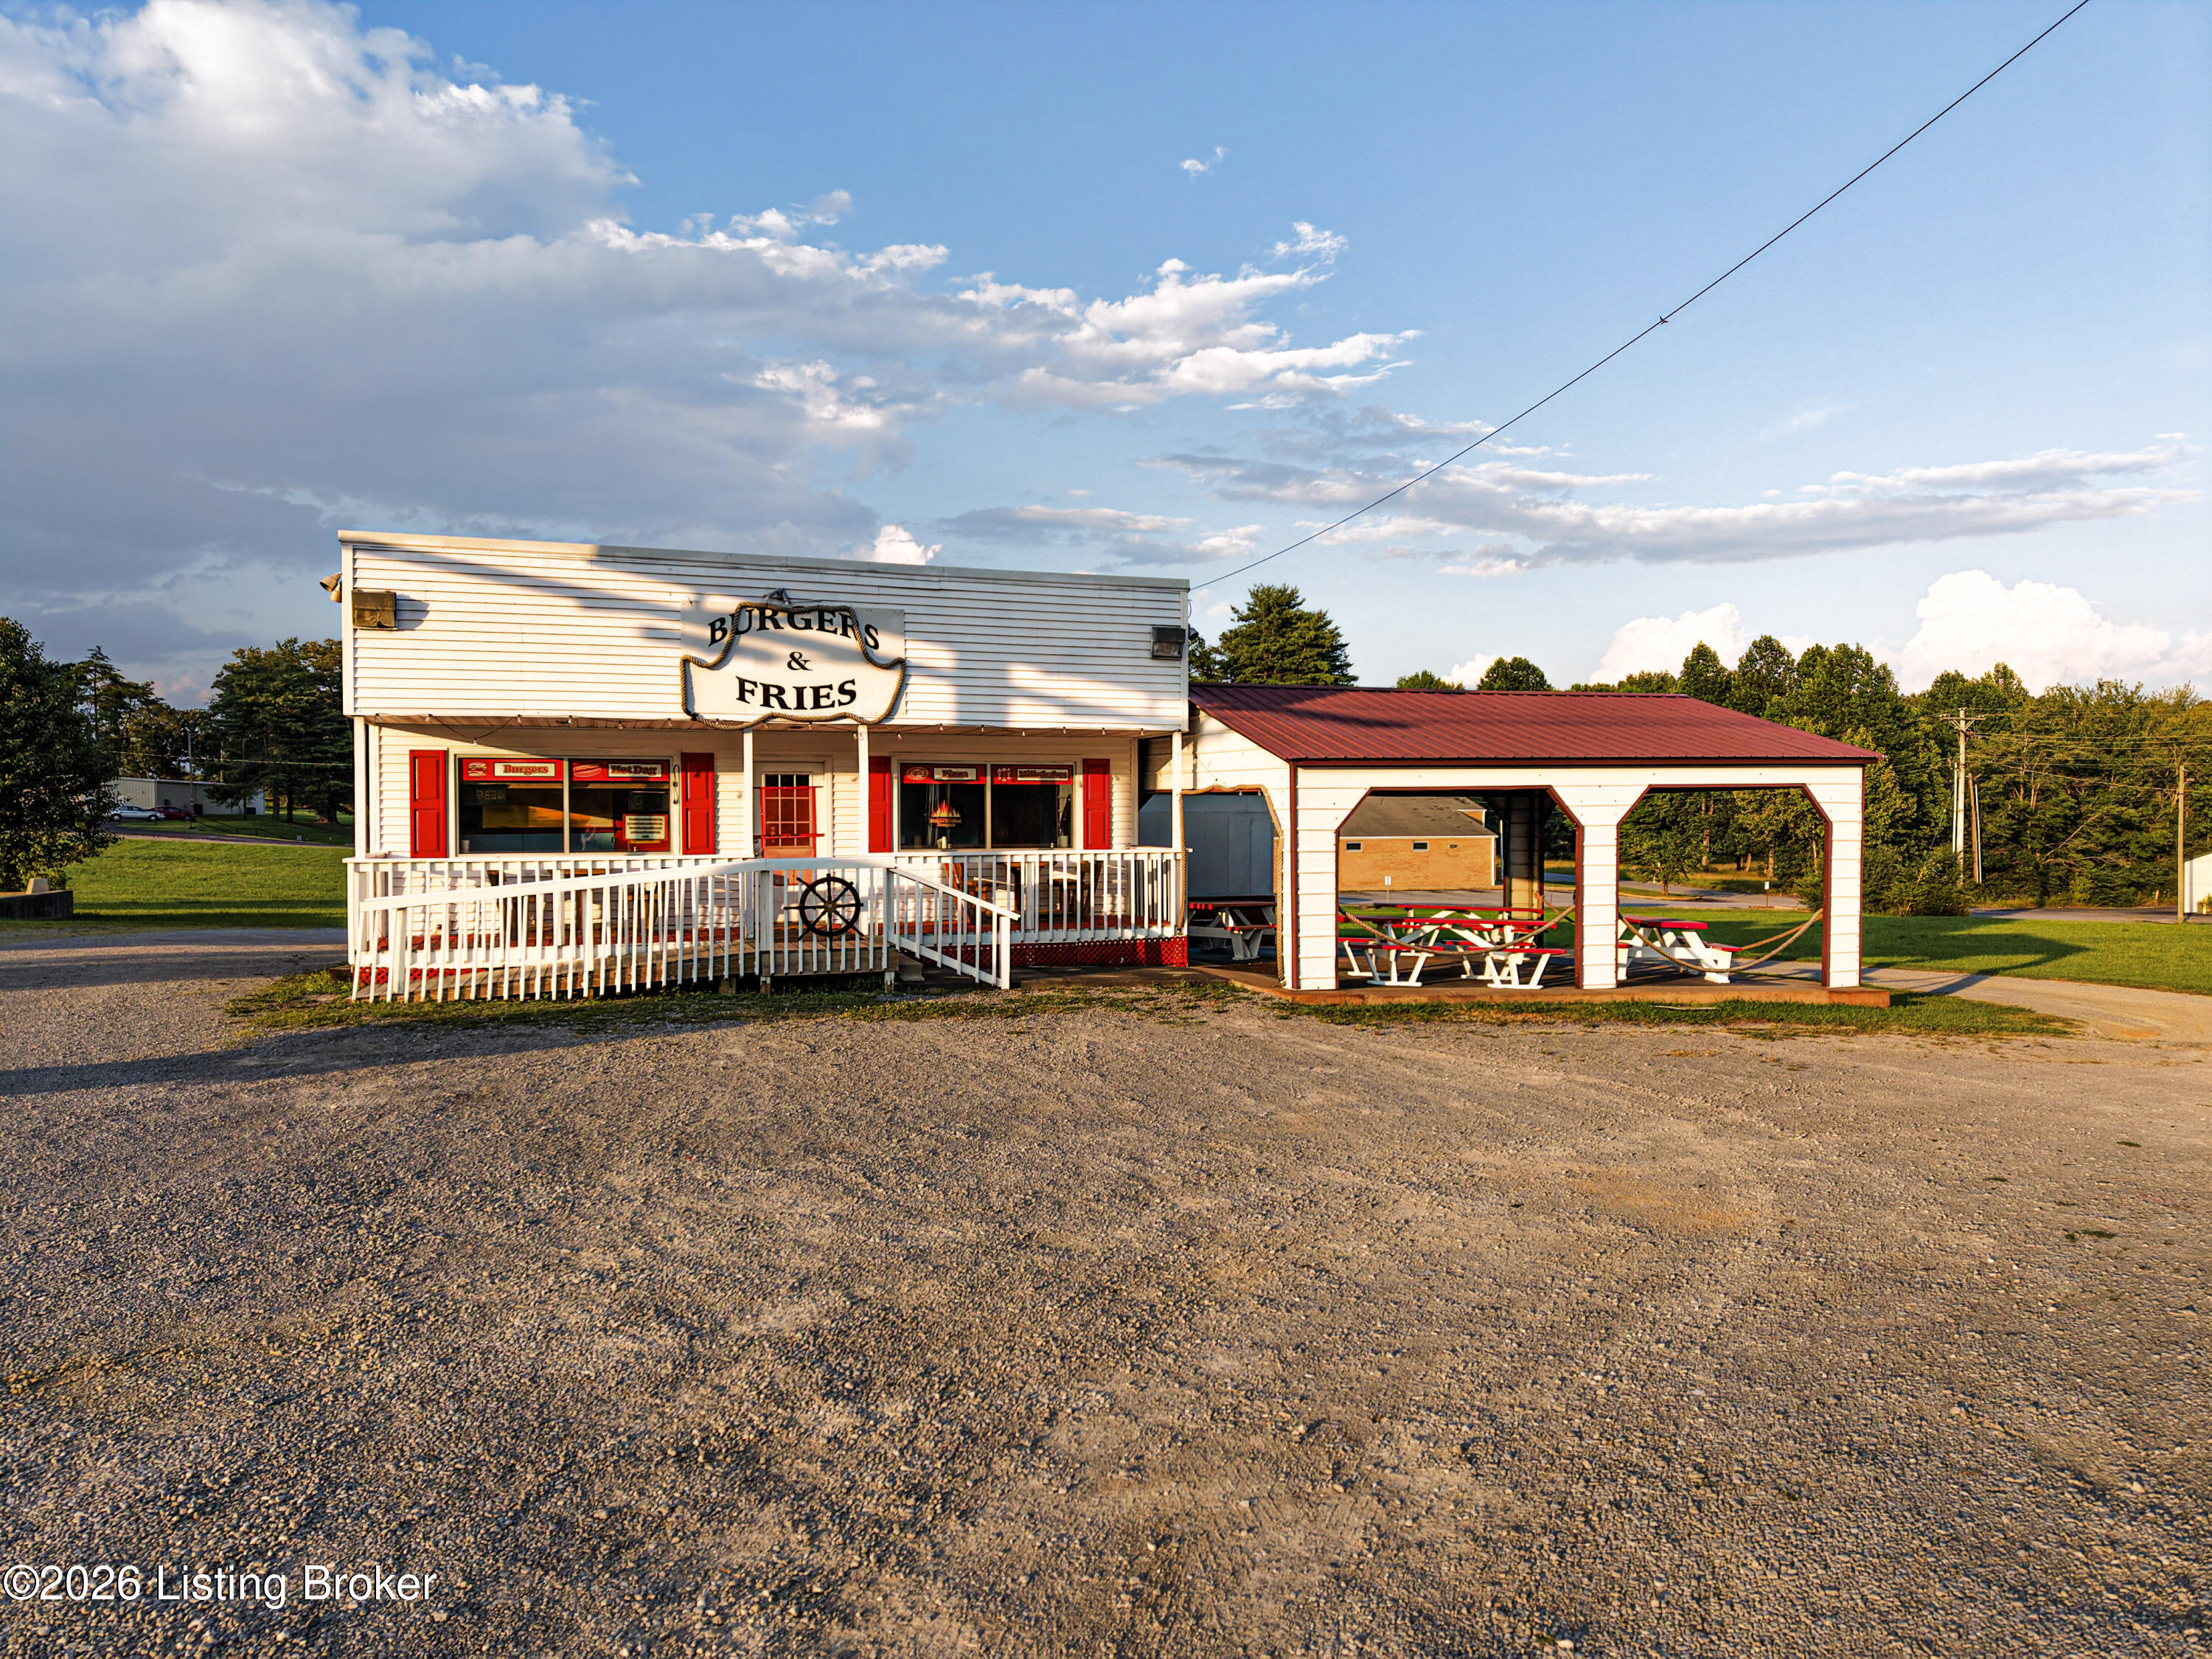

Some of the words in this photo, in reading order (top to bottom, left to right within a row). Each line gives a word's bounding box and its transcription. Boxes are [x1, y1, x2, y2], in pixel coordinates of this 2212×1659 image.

[708, 605, 880, 650] BURGERS
[787, 651, 813, 671] &
[735, 675, 857, 710] FRIES
[503, 764, 549, 776] Burgers
